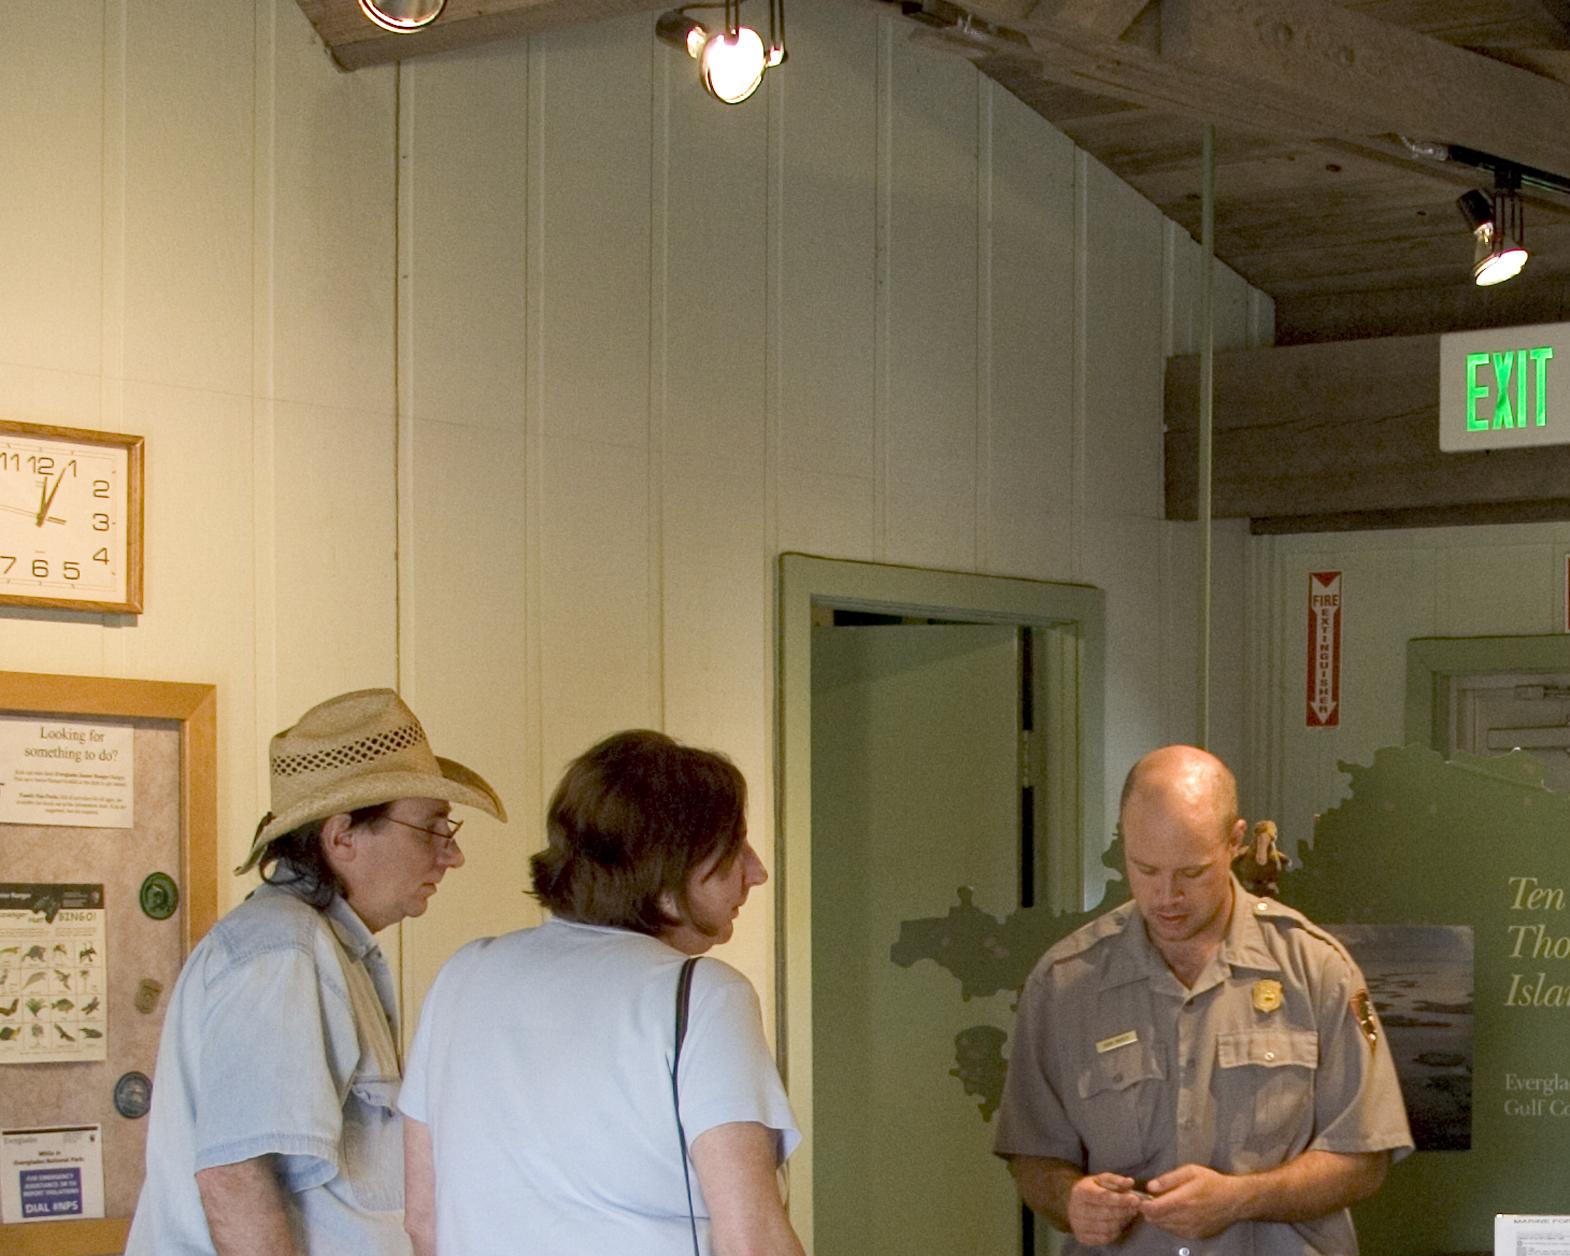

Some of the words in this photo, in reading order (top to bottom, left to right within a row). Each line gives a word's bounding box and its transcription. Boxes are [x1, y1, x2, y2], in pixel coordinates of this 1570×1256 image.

[1465, 346, 1554, 432] EXIT
[27, 456, 55, 476] 12
[67, 459, 78, 478] 1
[93, 480, 110, 499] 2
[93, 513, 110, 532] 3
[92, 547, 110, 565] 4
[0, 556, 16, 574] 7
[32, 560, 49, 578] 6
[63, 561, 81, 580] 5
[1313, 594, 1339, 608] FIRE
[1320, 609, 1329, 714] EXTINGUISHER
[40, 727, 86, 744] Looking
[90, 729, 105, 742] for
[24, 746, 82, 763] something
[85, 750, 95, 760] to
[99, 749, 119, 762] do?
[1507, 876, 1565, 911] Ten
[1504, 1099, 1545, 1117] Gulf
[25, 1202, 50, 1214] DIAL
[52, 1200, 79, 1212] #NPS
